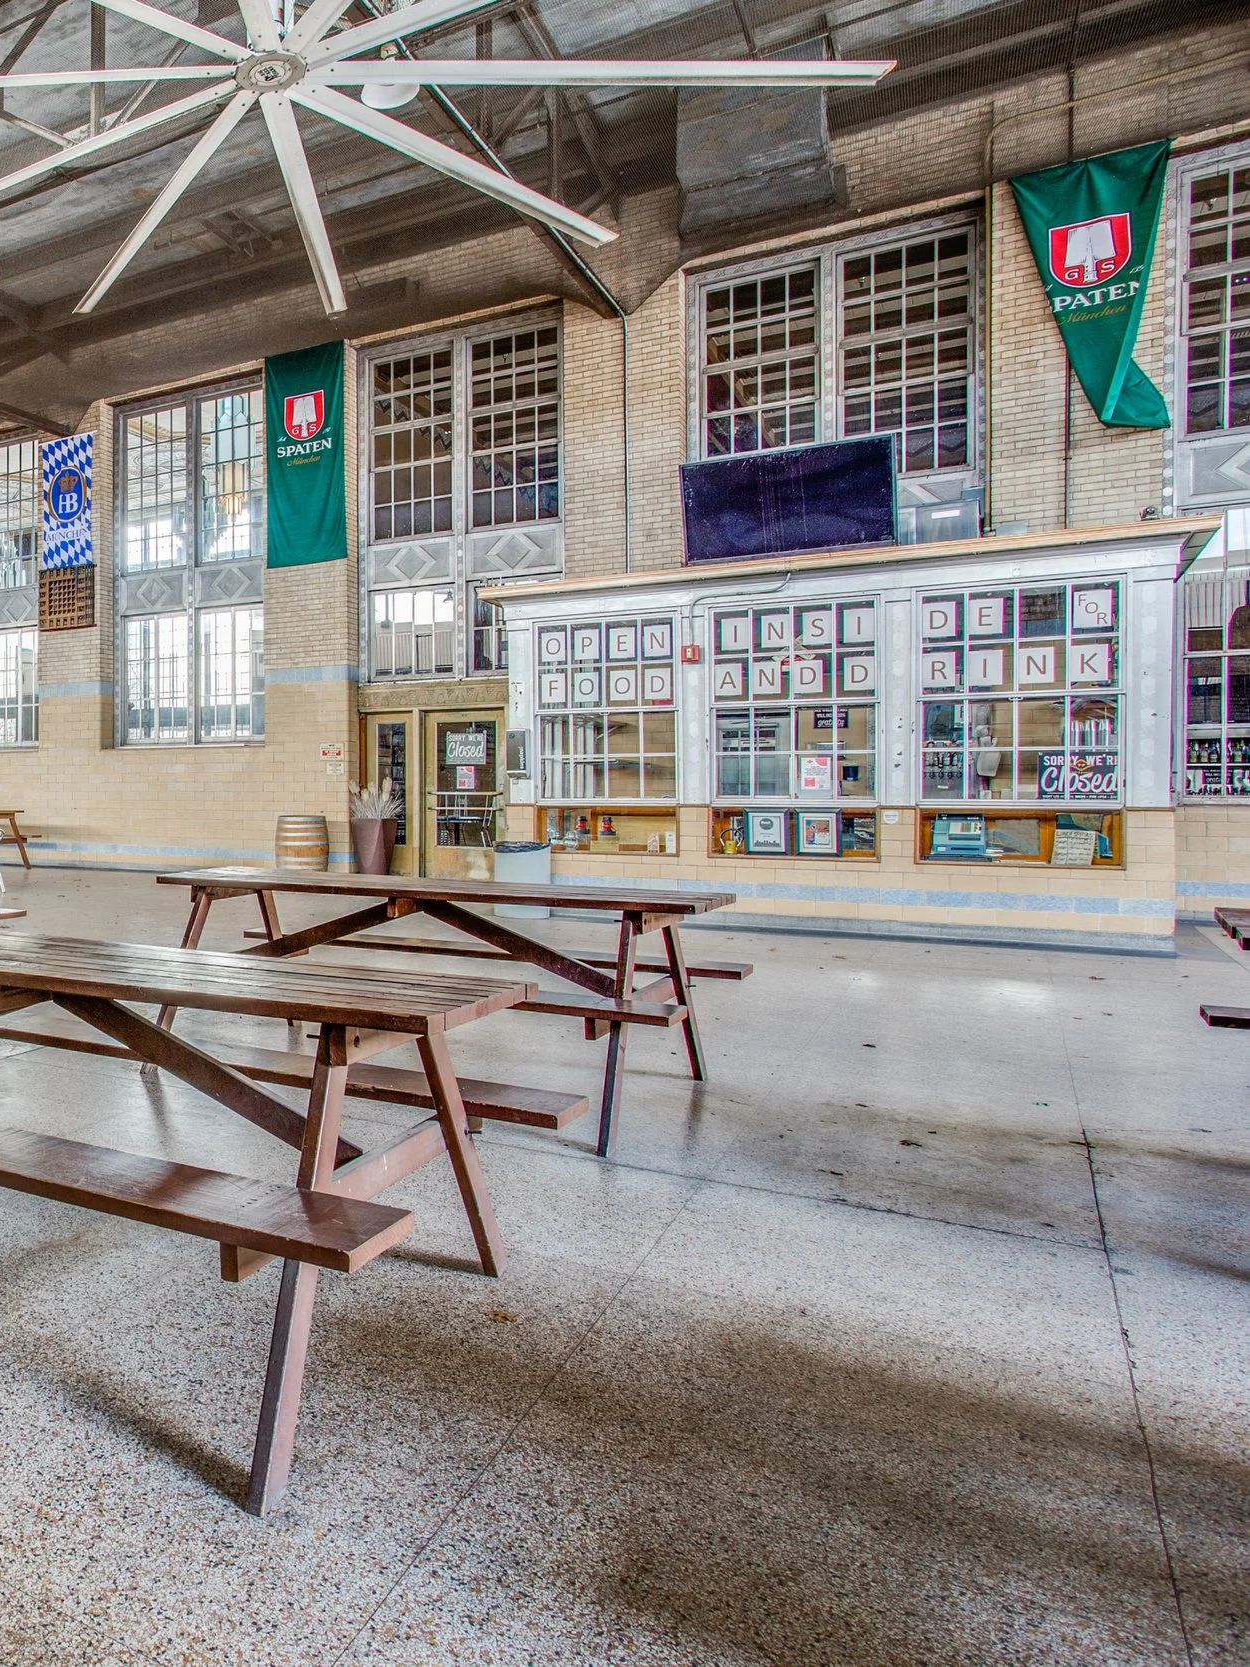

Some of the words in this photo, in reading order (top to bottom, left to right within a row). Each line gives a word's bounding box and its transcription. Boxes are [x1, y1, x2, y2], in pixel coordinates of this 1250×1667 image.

[1065, 269, 1080, 280] G
[1101, 261, 1115, 273] S
[277, 438, 332, 458] SPATEN
[58, 492, 79, 514] HB
[545, 631, 665, 656] OPEN
[1077, 593, 1108, 625] FOR
[549, 674, 665, 697] FOOD
[719, 665, 817, 690] AND
[448, 741, 484, 757] Closed
[1041, 766, 1118, 793] Closed
